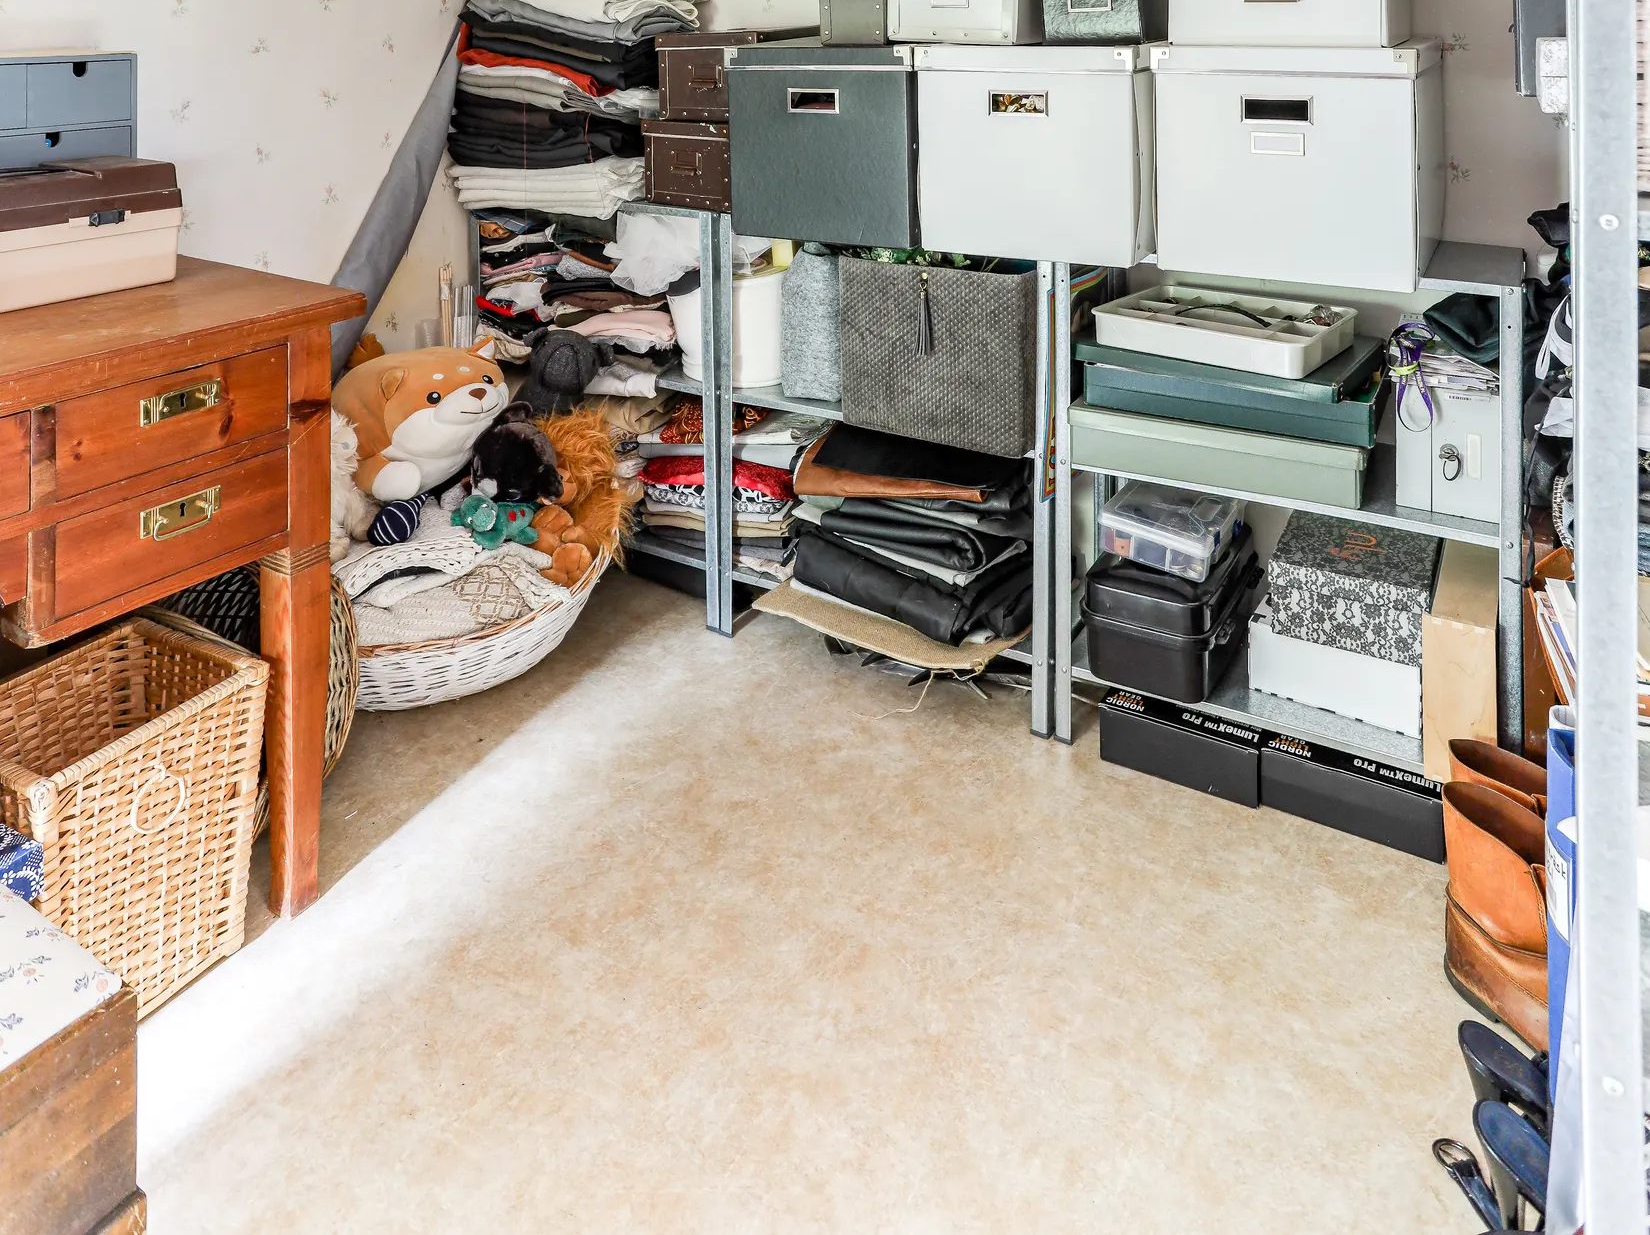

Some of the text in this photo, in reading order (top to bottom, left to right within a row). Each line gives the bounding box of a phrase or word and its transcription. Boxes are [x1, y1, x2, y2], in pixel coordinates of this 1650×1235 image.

[1112, 693, 1144, 706] LIGHT
[1119, 691, 1142, 700] GEAR
[1106, 696, 1145, 712] NORDIC
[1182, 712, 1203, 725] Pro
[1274, 737, 1310, 752] LIGHT
[1281, 734, 1306, 745] GEAR
[1268, 740, 1312, 758] NORDIC
[1353, 758, 1377, 773] Pro
